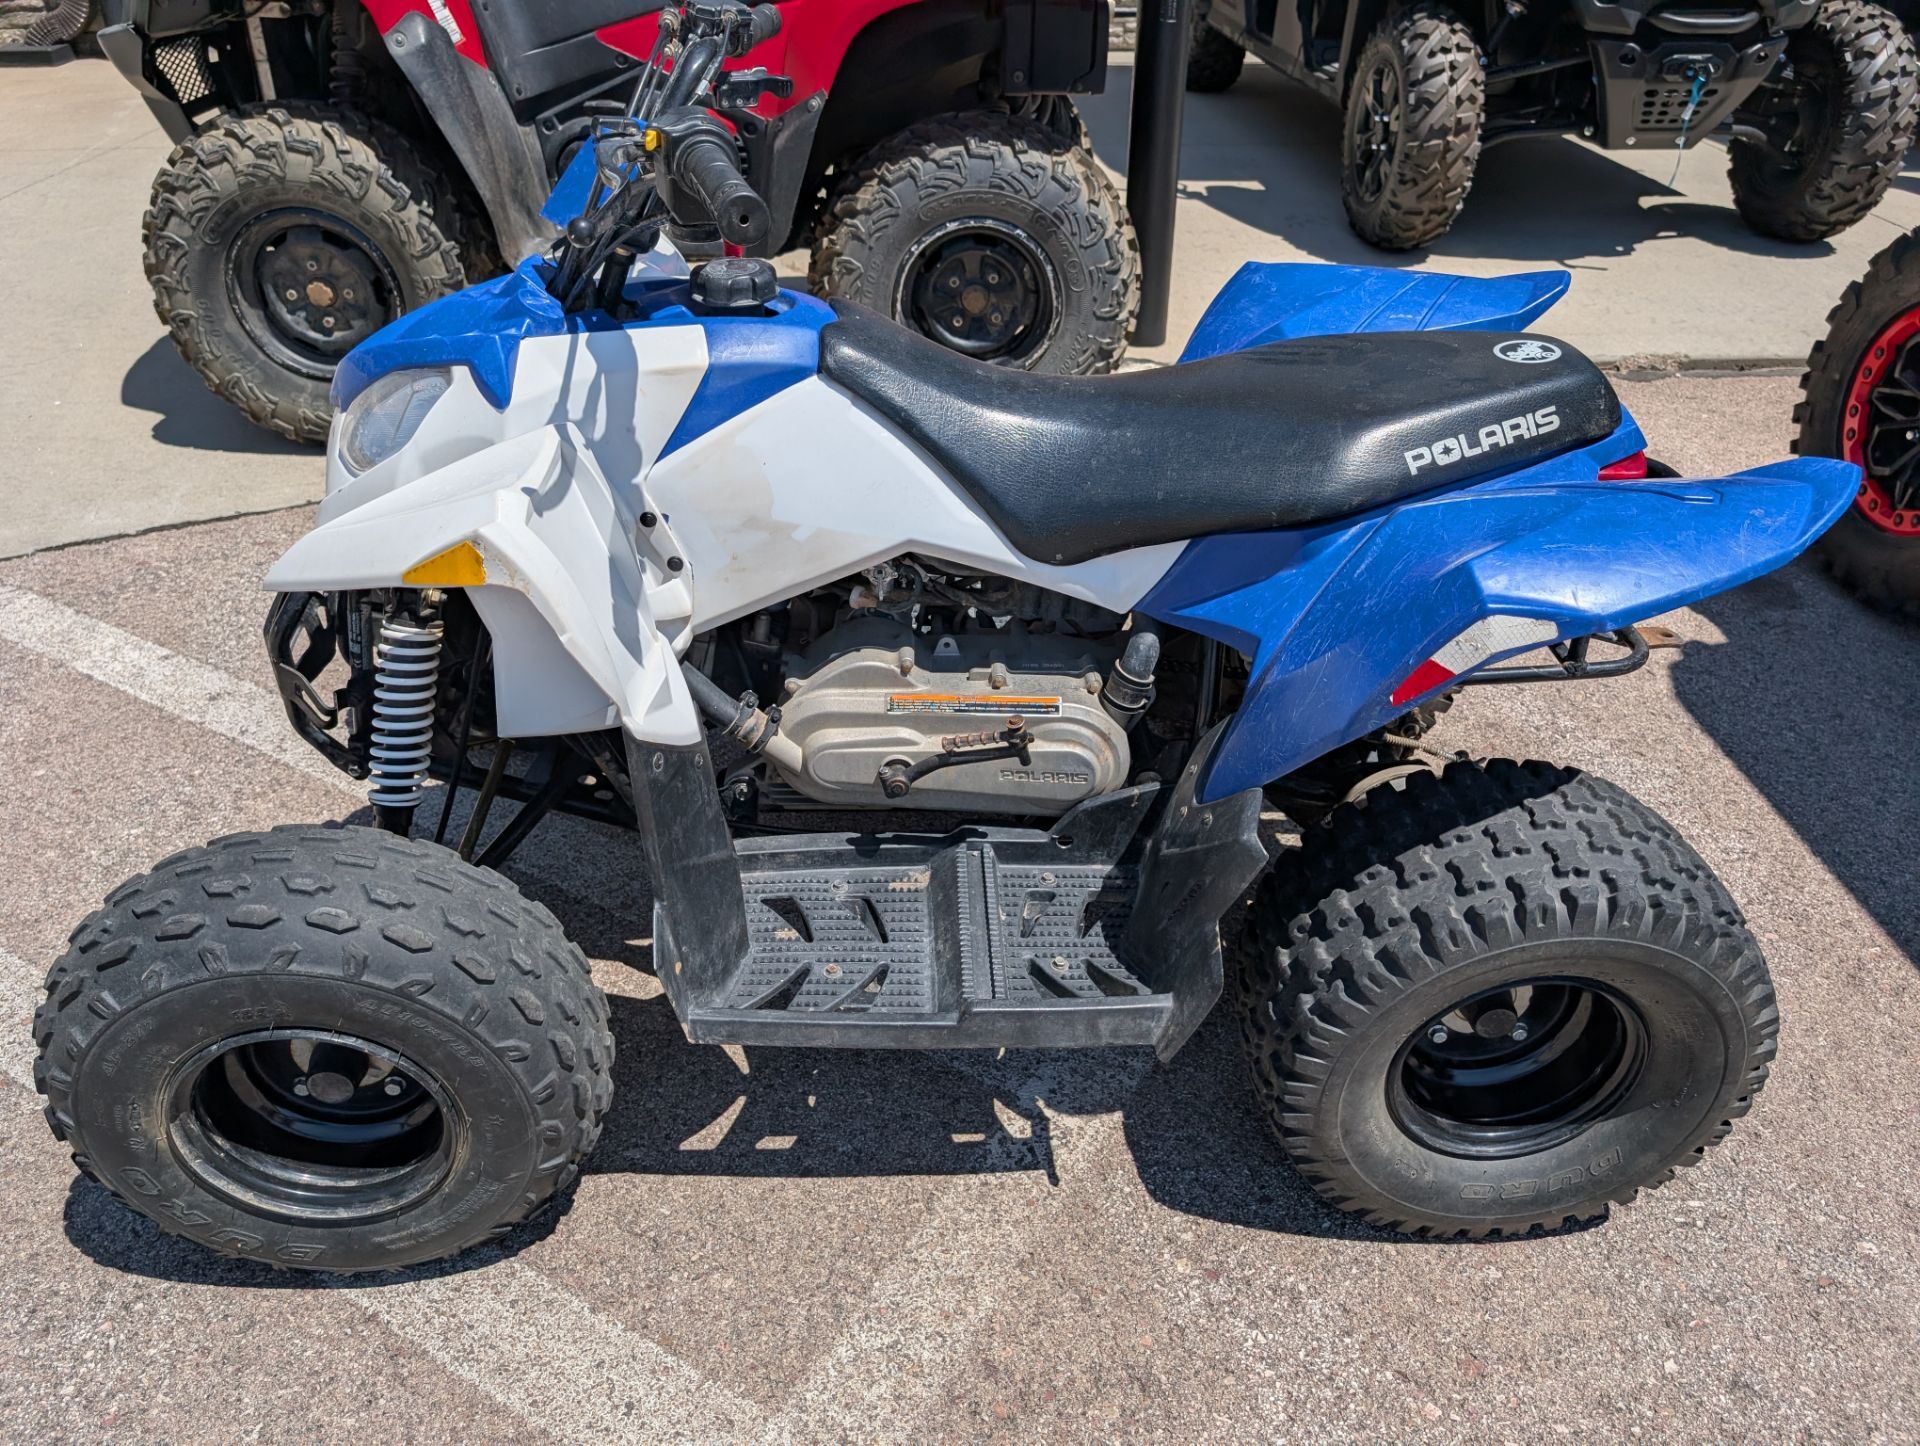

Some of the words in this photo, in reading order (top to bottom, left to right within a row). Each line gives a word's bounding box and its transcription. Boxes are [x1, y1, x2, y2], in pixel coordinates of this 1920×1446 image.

[1404, 405, 1560, 475] POLARIS
[998, 769, 1088, 784] POLARIS
[1459, 1146, 1623, 1199] DURO
[119, 1166, 327, 1261] DURO
